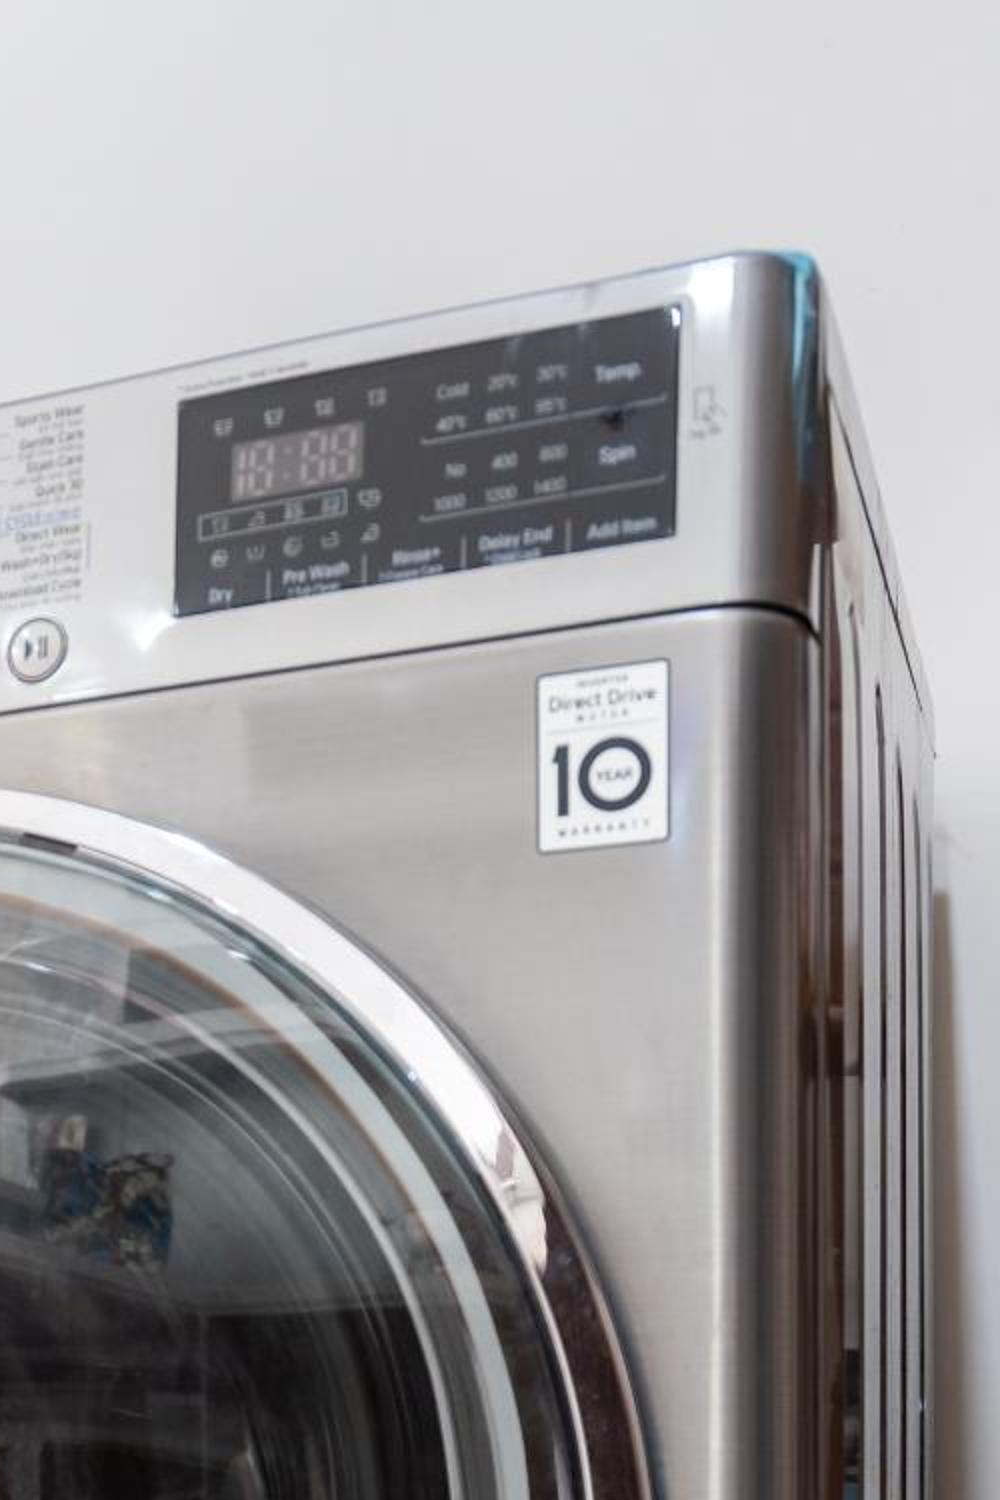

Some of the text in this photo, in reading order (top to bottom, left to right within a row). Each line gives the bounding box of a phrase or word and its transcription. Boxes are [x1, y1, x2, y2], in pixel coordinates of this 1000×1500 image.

[436, 381, 471, 401] Cold
[599, 444, 637, 465] Spin
[478, 525, 553, 553] Delay End
[587, 521, 620, 540] Add
[309, 560, 350, 580] Wash
[208, 587, 233, 609] Dry
[549, 687, 657, 714] Direct Drive
[552, 737, 652, 817] 10
